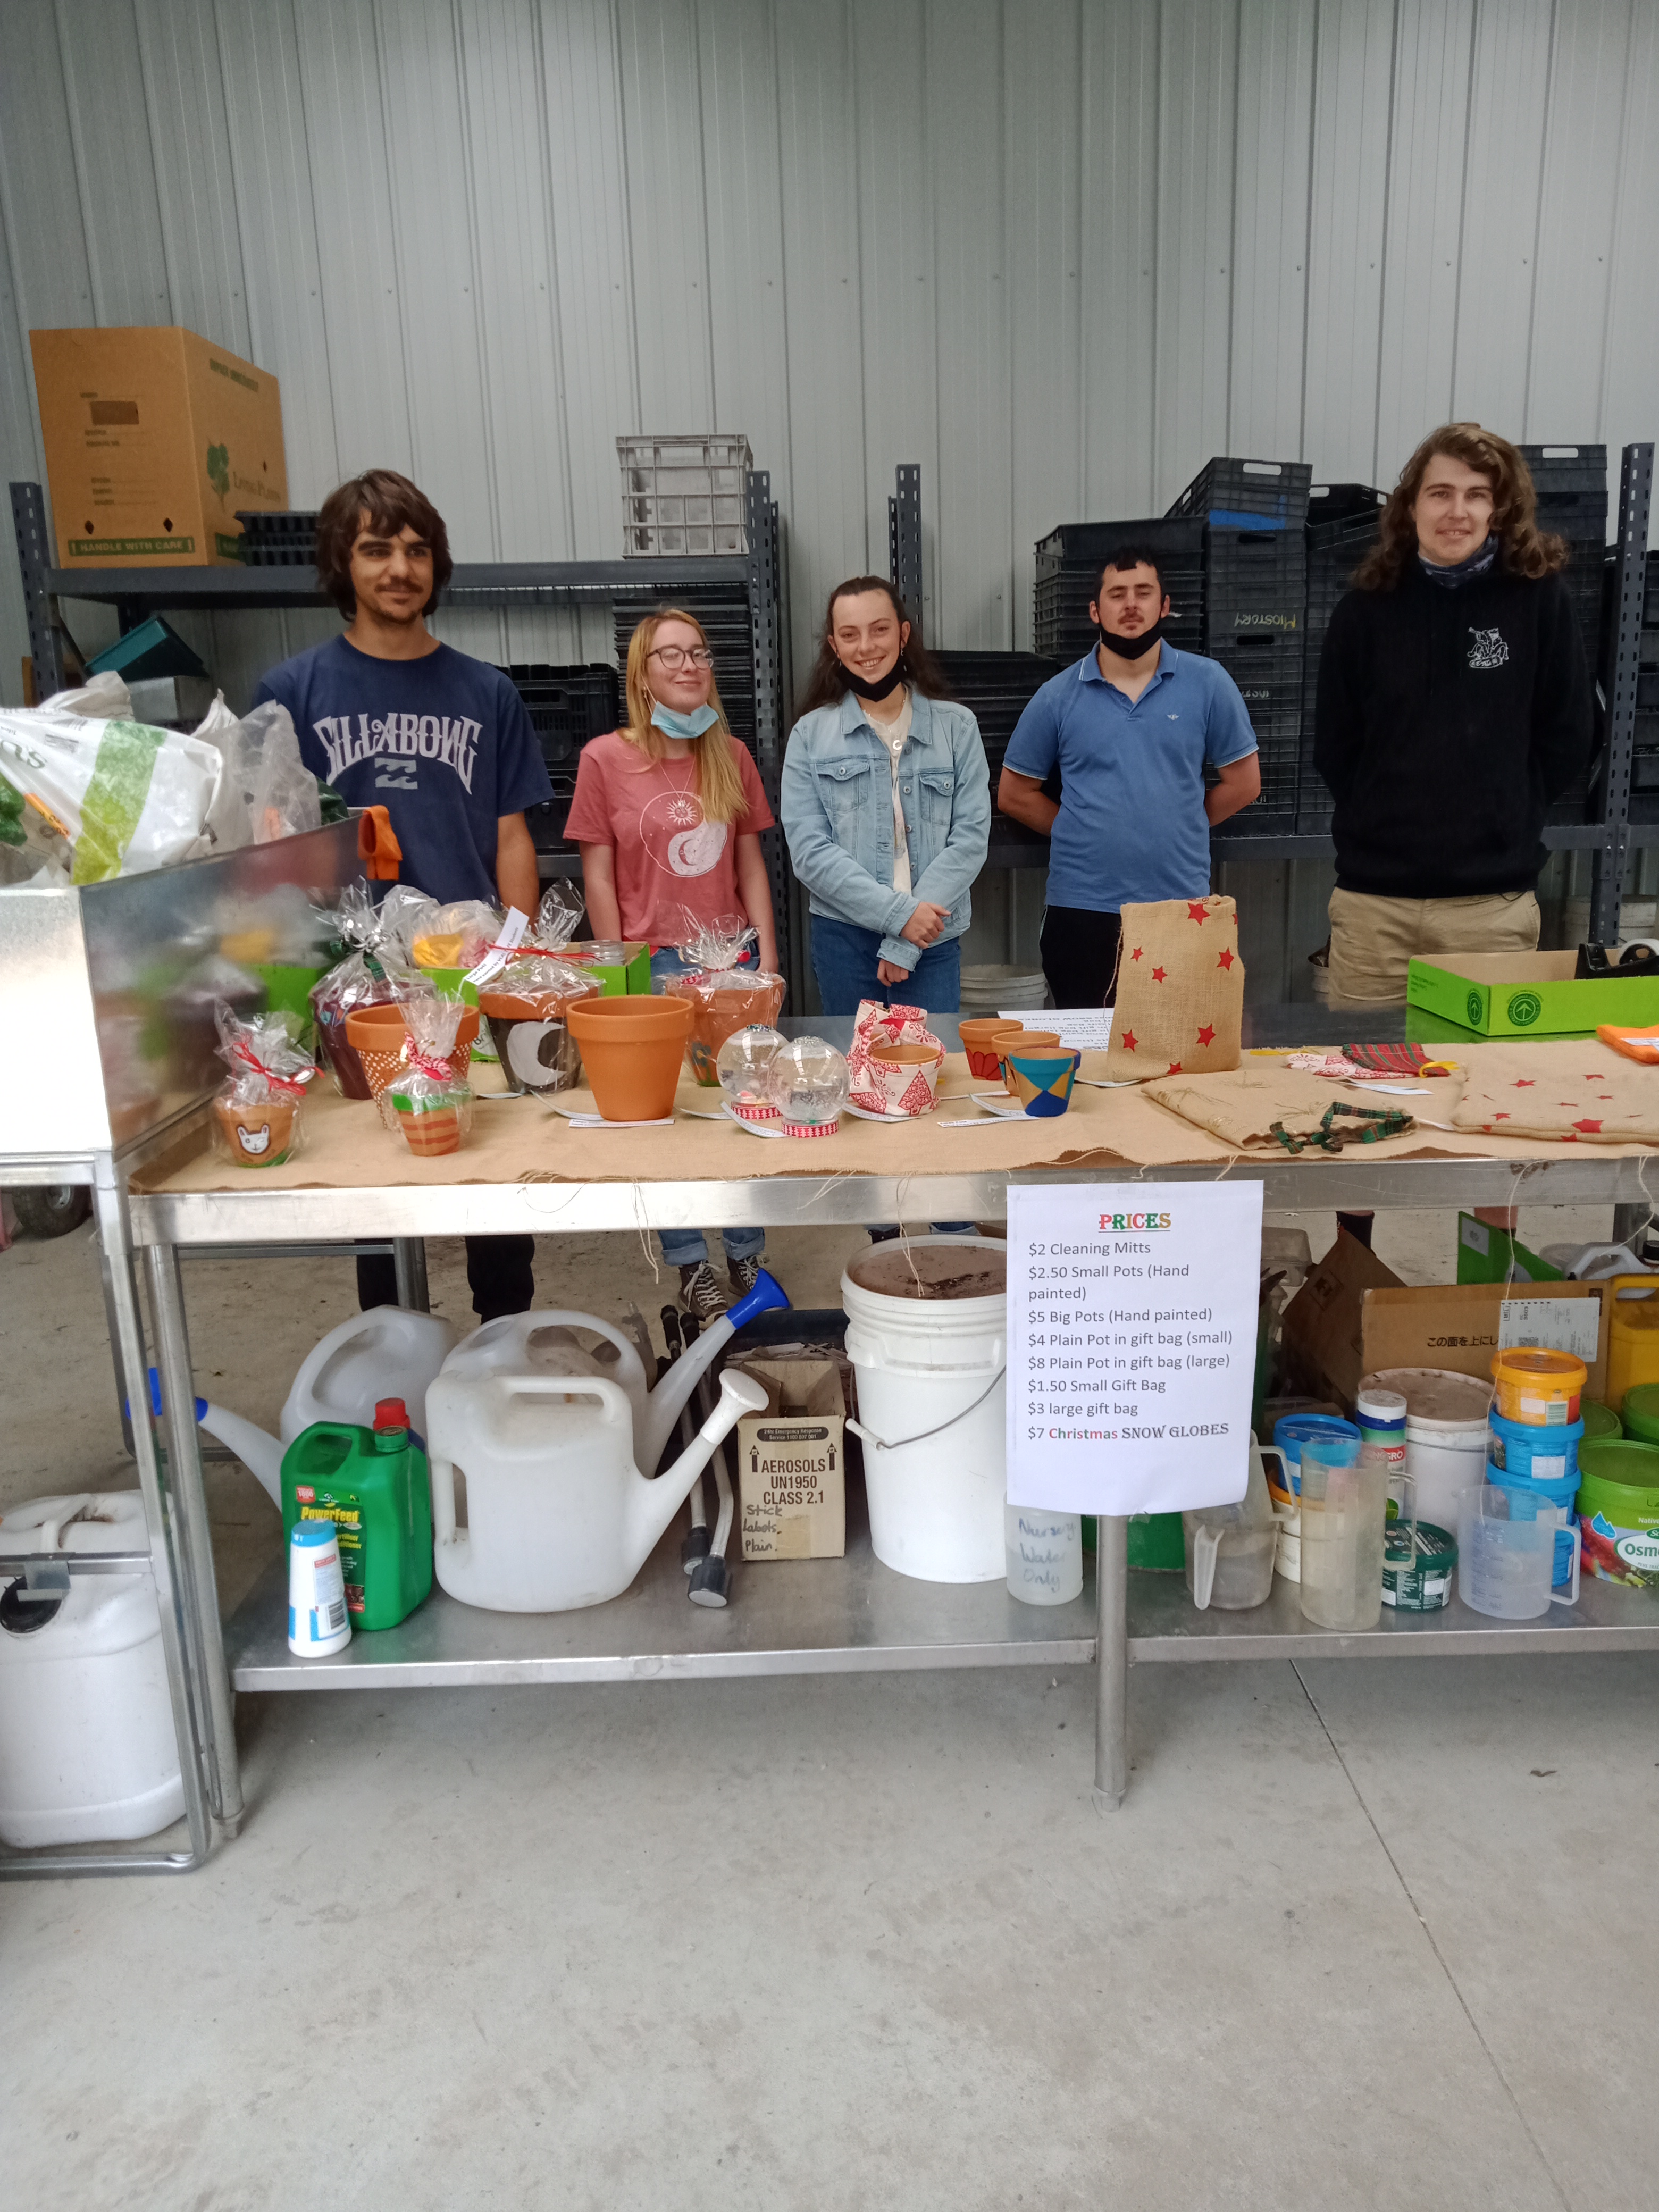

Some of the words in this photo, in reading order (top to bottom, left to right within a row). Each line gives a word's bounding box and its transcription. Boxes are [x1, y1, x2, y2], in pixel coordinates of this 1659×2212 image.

[80, 542, 122, 551] HANDLE
[125, 541, 152, 550] WITH
[155, 540, 183, 549] CARE
[313, 712, 483, 795] BILLABONG
[466, 971, 478, 980] Large
[478, 963, 487, 972] Pots
[1099, 1213, 1172, 1229] PRICES
[1029, 1242, 1046, 1257] $2
[1050, 1243, 1110, 1256] Cleaning
[1115, 1242, 1151, 1253] Mitts
[1029, 1266, 1068, 1281] $2.50
[1071, 1265, 1109, 1278] Small
[1113, 1266, 1143, 1277] Pots
[1147, 1264, 1189, 1279] (Hand
[1029, 1286, 1086, 1302] painted)
[1028, 1310, 1045, 1325] $5
[1050, 1311, 1070, 1326] Big
[1075, 1311, 1104, 1322] Pots
[1109, 1309, 1150, 1324] (Hand
[1154, 1308, 1212, 1323] painted)
[1028, 1333, 1046, 1348] $4
[1050, 1334, 1083, 1346] Plain
[1087, 1334, 1110, 1345] Pot
[1115, 1333, 1126, 1345] in
[1130, 1332, 1153, 1347] gift
[1158, 1332, 1183, 1347] bag
[1187, 1330, 1232, 1346] (small)
[1427, 1335, 1499, 1347] この面を上にし
[1028, 1356, 1045, 1370] $8
[1050, 1357, 1082, 1369] Plain
[1087, 1357, 1110, 1369] Pot
[1114, 1356, 1126, 1368] in
[1130, 1355, 1153, 1371] gift
[1158, 1355, 1182, 1370] bag
[1186, 1354, 1229, 1370] (large)
[1028, 1379, 1067, 1393] $1.50
[1070, 1379, 1107, 1392] Small
[1111, 1379, 1137, 1392] Gift
[1141, 1379, 1166, 1394] Bag
[1028, 1401, 1044, 1415] $3
[1049, 1402, 1083, 1417] large
[1086, 1402, 1110, 1417] gift
[1114, 1402, 1138, 1417] bag
[1028, 1426, 1045, 1440] $7
[1049, 1427, 1118, 1439] Christmas
[1121, 1425, 1167, 1439] SNOW
[1169, 1423, 1229, 1438] GLOBES
[761, 1458, 826, 1473] AEROSOLS
[770, 1475, 817, 1489] UN1950
[764, 1491, 803, 1505] CLASS
[807, 1490, 824, 1504] 2.1
[301, 1507, 359, 1522] PowerFeed
[746, 1504, 783, 1516] Stick
[1624, 1543, 1659, 1557] Osm
[1024, 1568, 1060, 1593] Only
